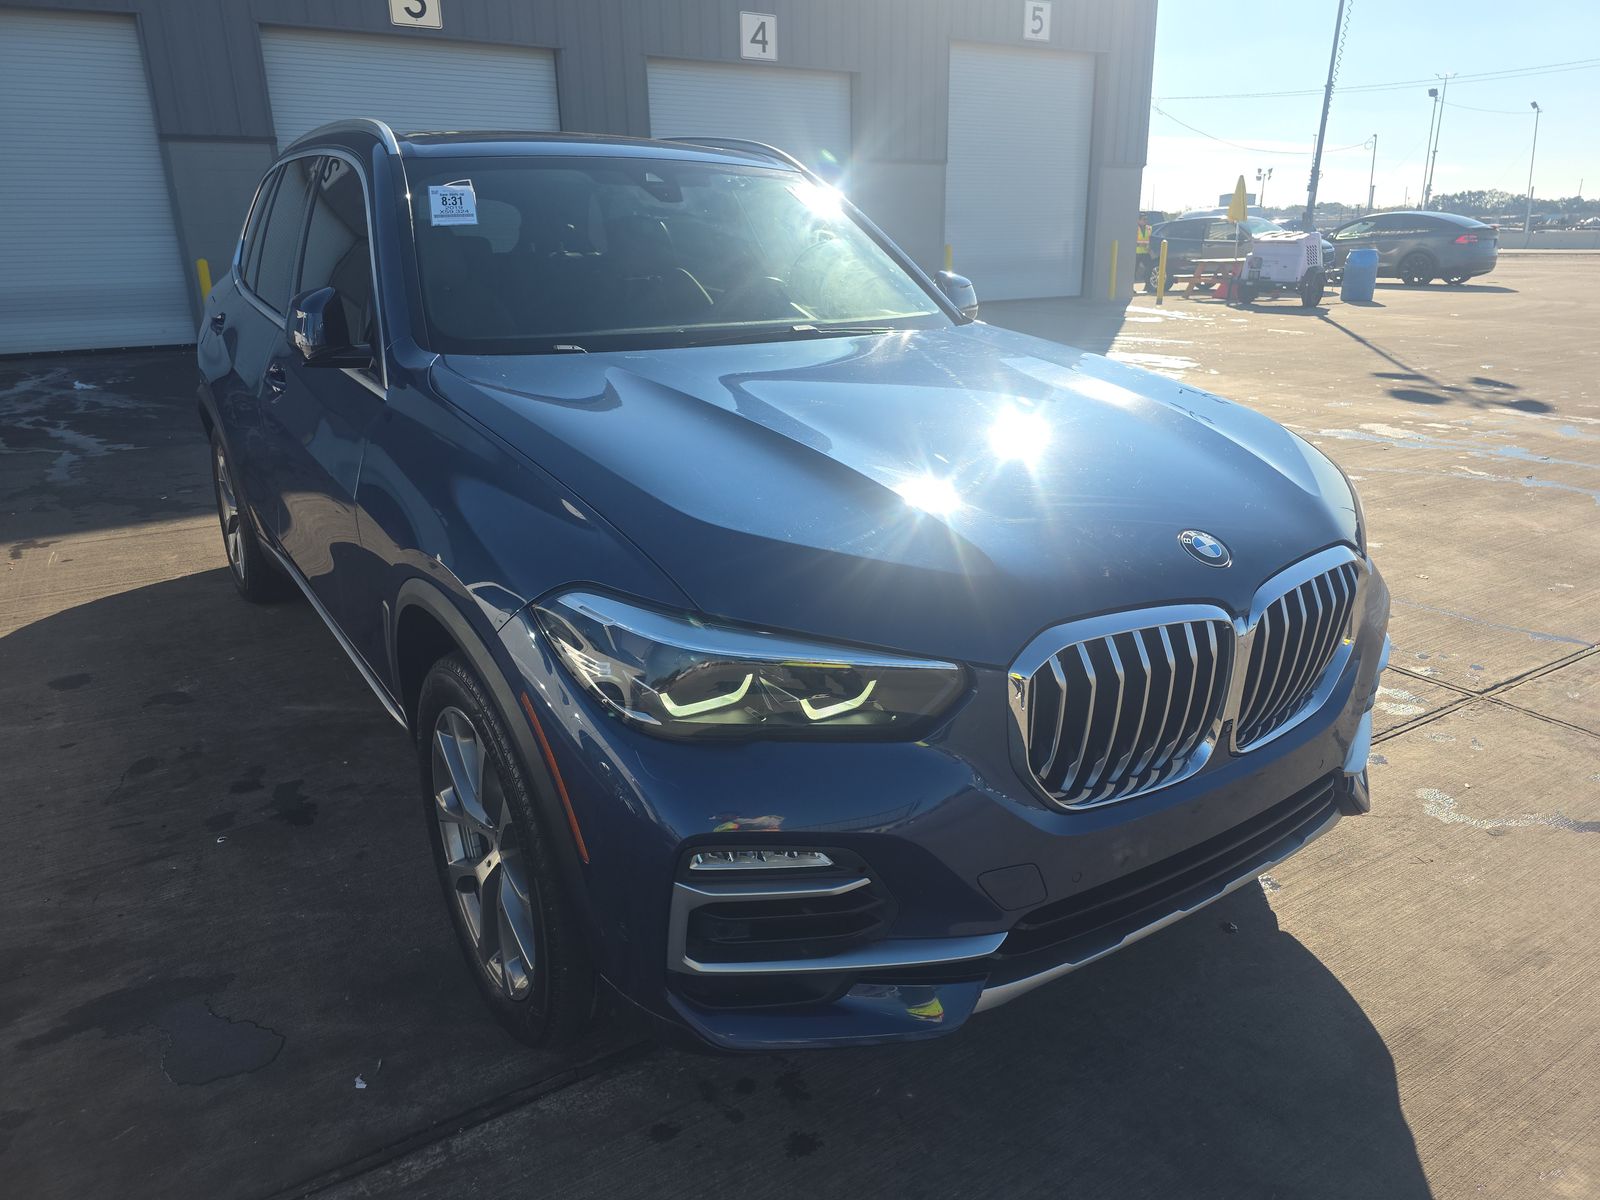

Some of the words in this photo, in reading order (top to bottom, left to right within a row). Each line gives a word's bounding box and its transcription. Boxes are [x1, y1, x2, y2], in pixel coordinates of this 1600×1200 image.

[1031, 6, 1044, 34] 5
[750, 21, 768, 53] 4
[441, 196, 463, 206] 8:31
